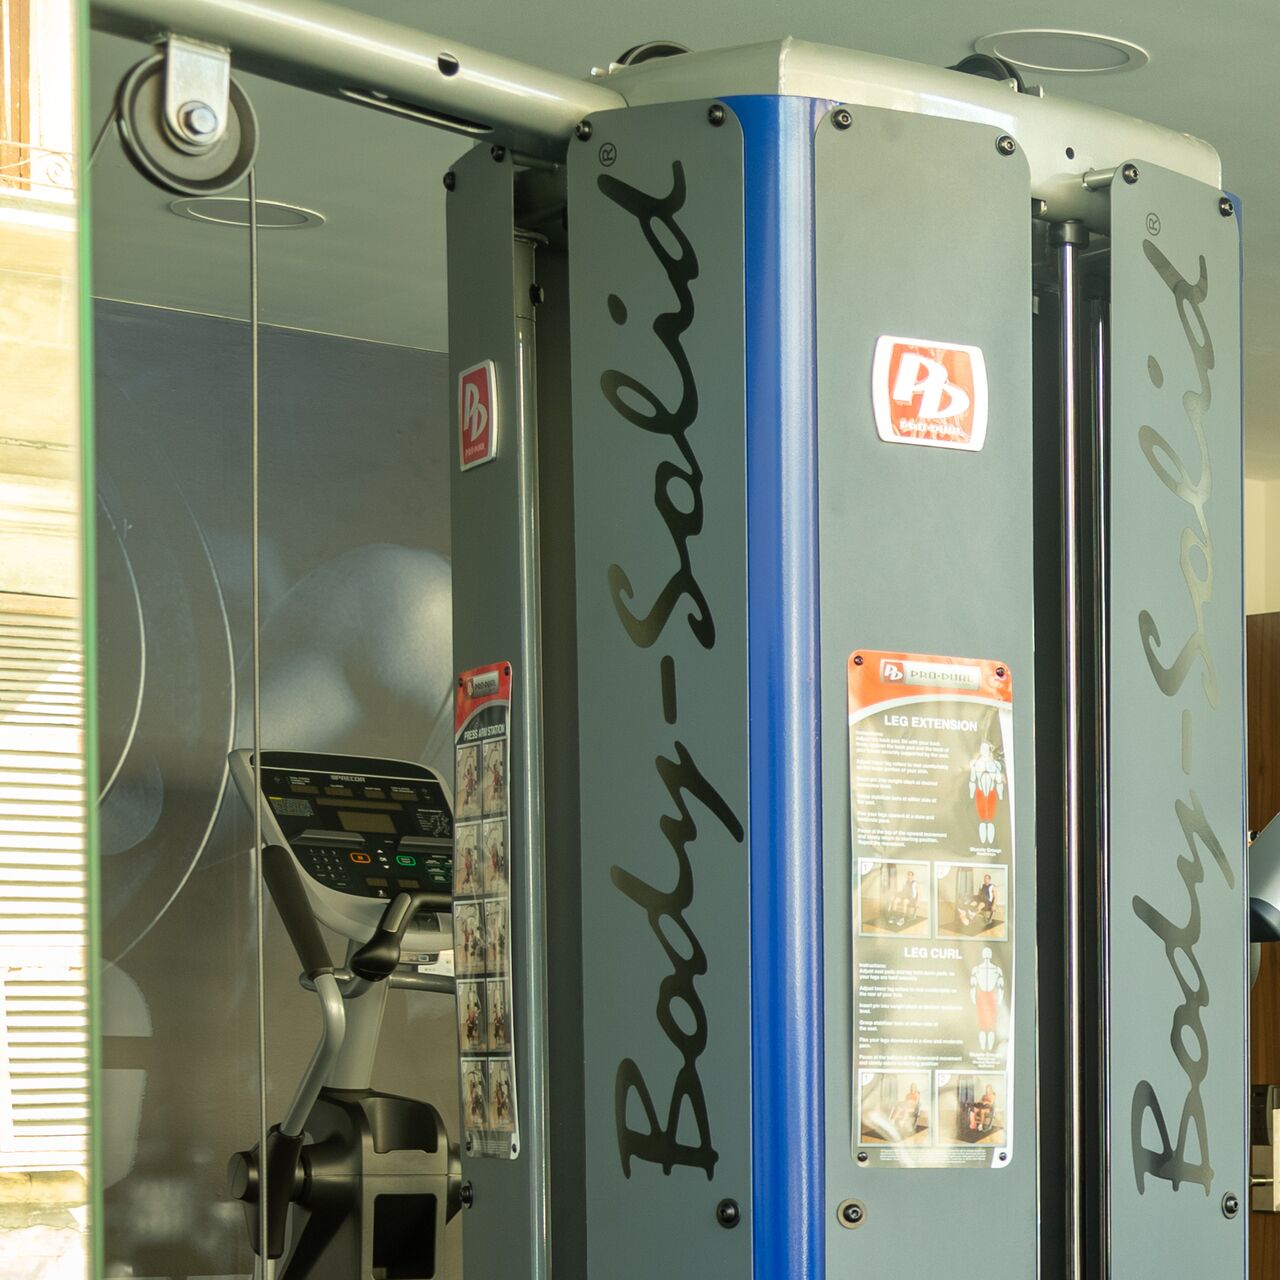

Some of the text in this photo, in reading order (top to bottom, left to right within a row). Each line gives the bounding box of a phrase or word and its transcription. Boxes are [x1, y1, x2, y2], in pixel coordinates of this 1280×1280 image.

[597, 160, 744, 1181] Body-Solid
[884, 714, 977, 731] LEG EXTENSION
[1131, 238, 1235, 1196] Body-Solid
[904, 946, 962, 960] LEG CURL
